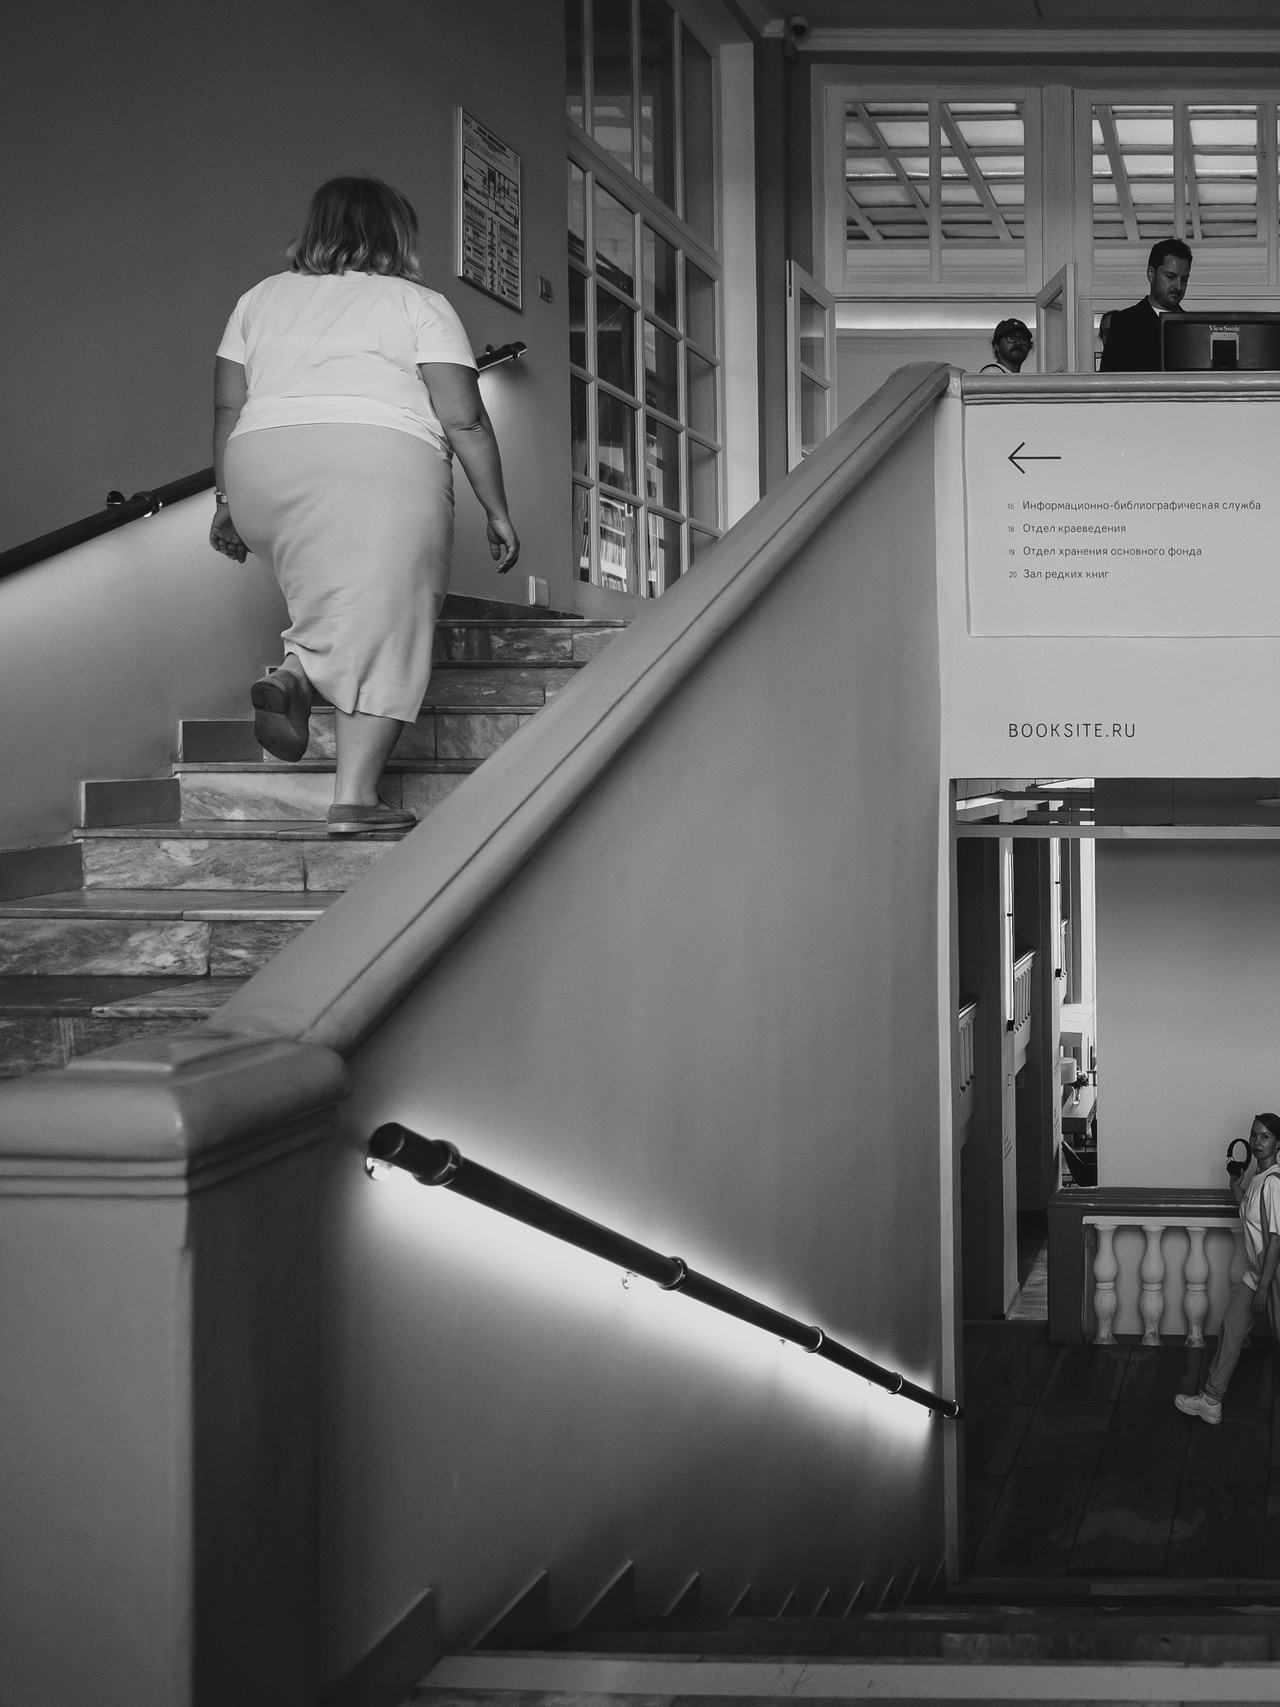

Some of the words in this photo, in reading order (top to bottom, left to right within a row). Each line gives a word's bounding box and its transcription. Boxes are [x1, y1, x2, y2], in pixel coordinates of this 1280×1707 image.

[1208, 324, 1241, 332] ViewSonic
[1007, 502, 1015, 510] 15
[1022, 500, 1219, 512] Информационно-библиографическая
[1221, 499, 1261, 511] служба
[1007, 525, 1015, 533] 18
[1022, 523, 1056, 534] Отдел
[1058, 525, 1127, 535] краеведения
[1008, 548, 1016, 556] 19
[1022, 546, 1056, 557] Отдел
[1058, 548, 1108, 558] хранения
[1110, 548, 1166, 556] основного
[1168, 546, 1202, 558] фонда
[1023, 568, 1043, 579] Зал
[1045, 570, 1083, 580] редких
[1085, 571, 1110, 579] книг
[1008, 722, 1136, 739] BOOKSITE.RU
